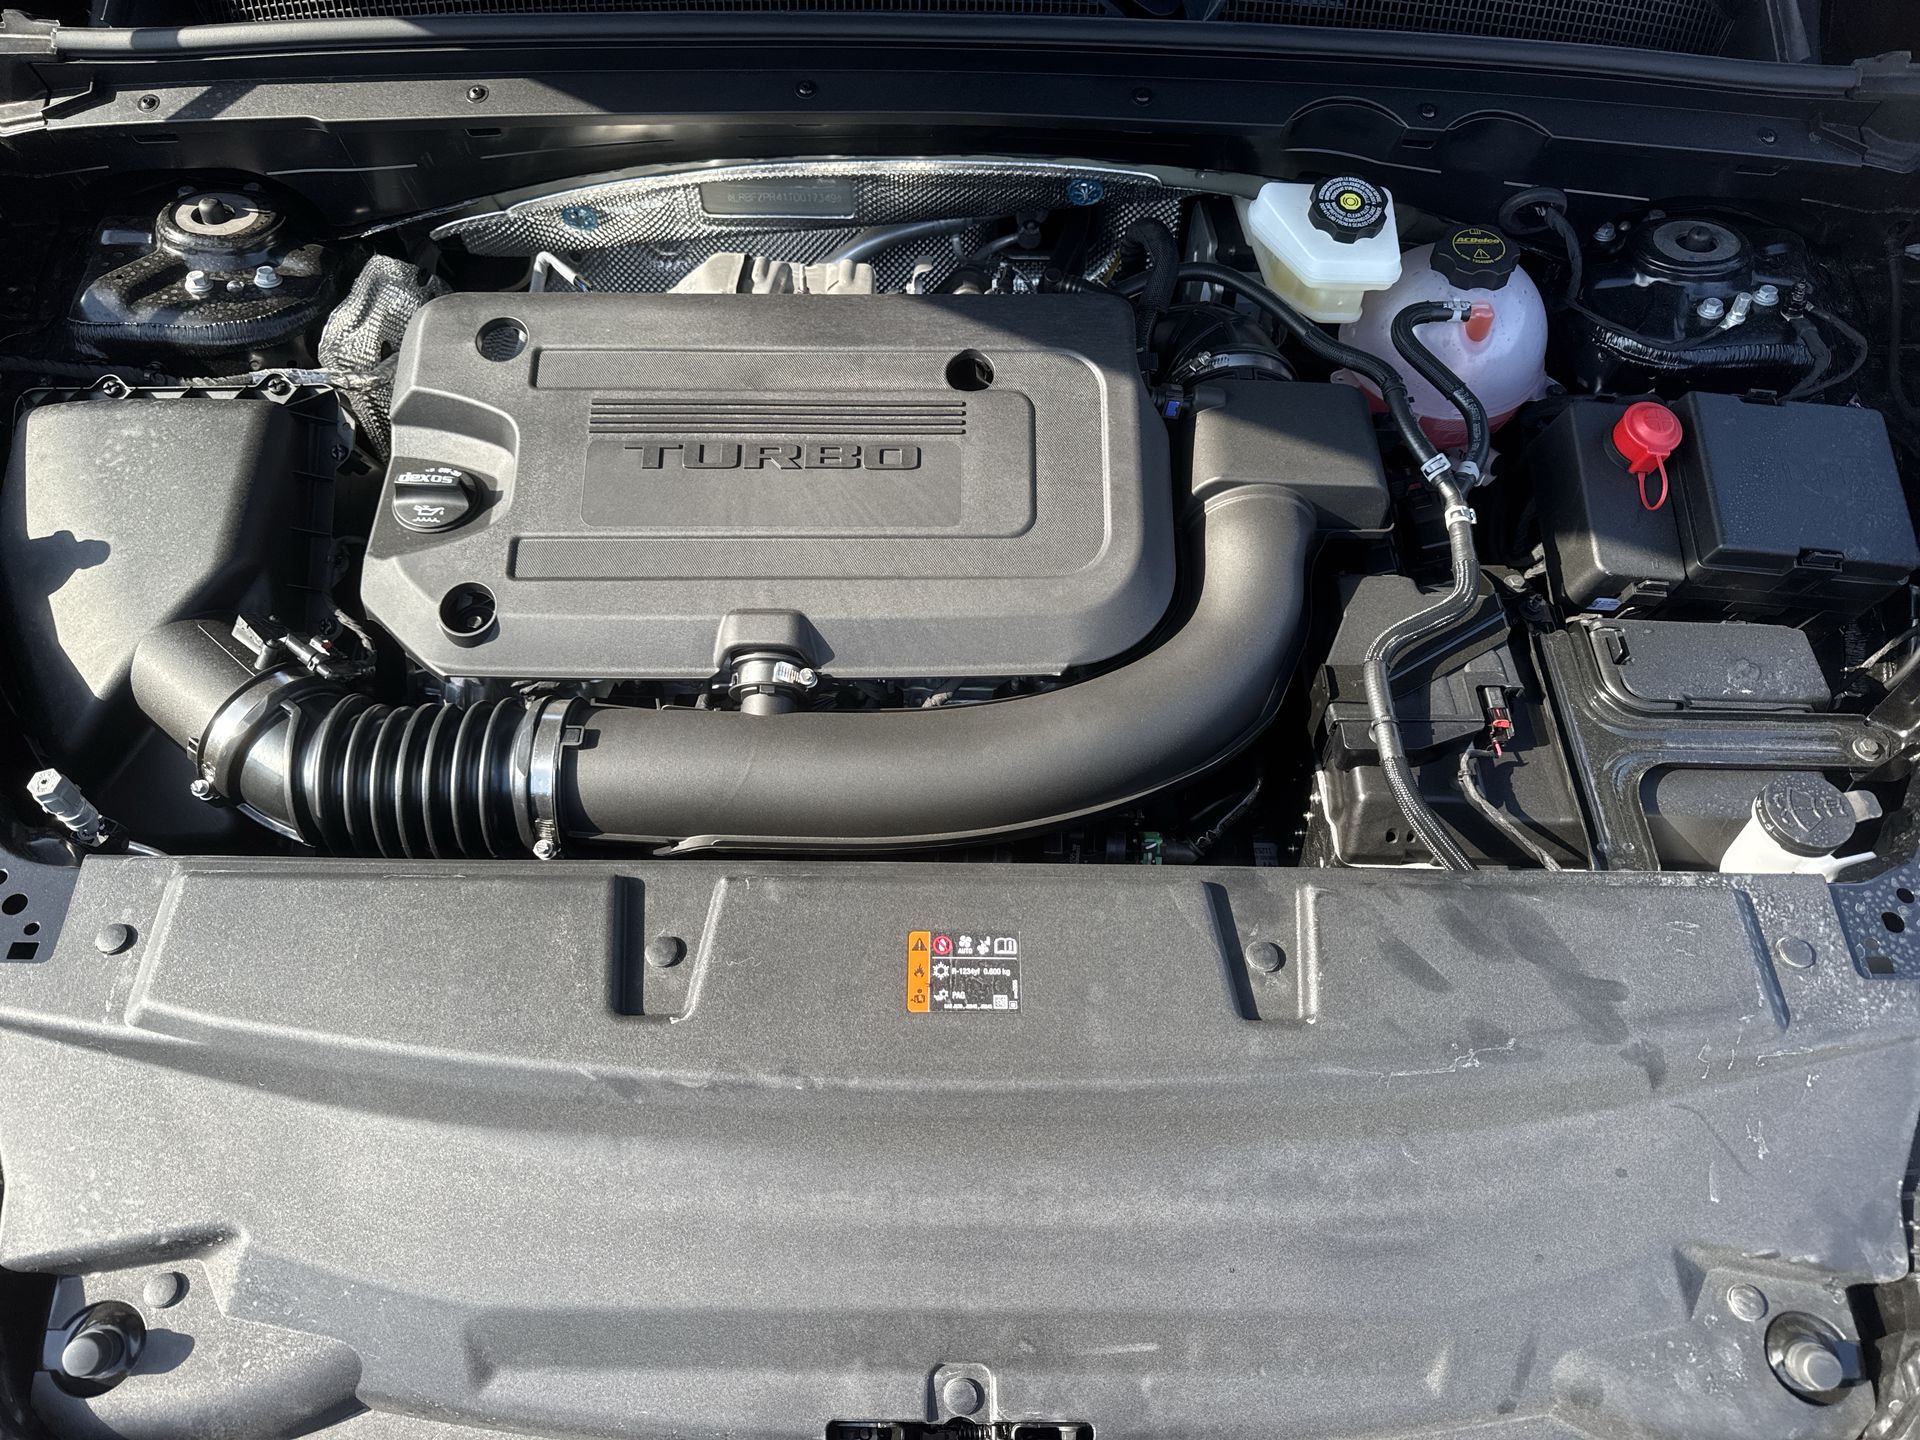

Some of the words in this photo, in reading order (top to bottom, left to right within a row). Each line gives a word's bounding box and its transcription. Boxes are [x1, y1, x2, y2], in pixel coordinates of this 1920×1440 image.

[623, 443, 922, 471] TURBO
[398, 472, 453, 483] dexos
[951, 968, 980, 976] R-1234yf
[1002, 968, 1011, 976] kg
[951, 991, 966, 999] PAG
